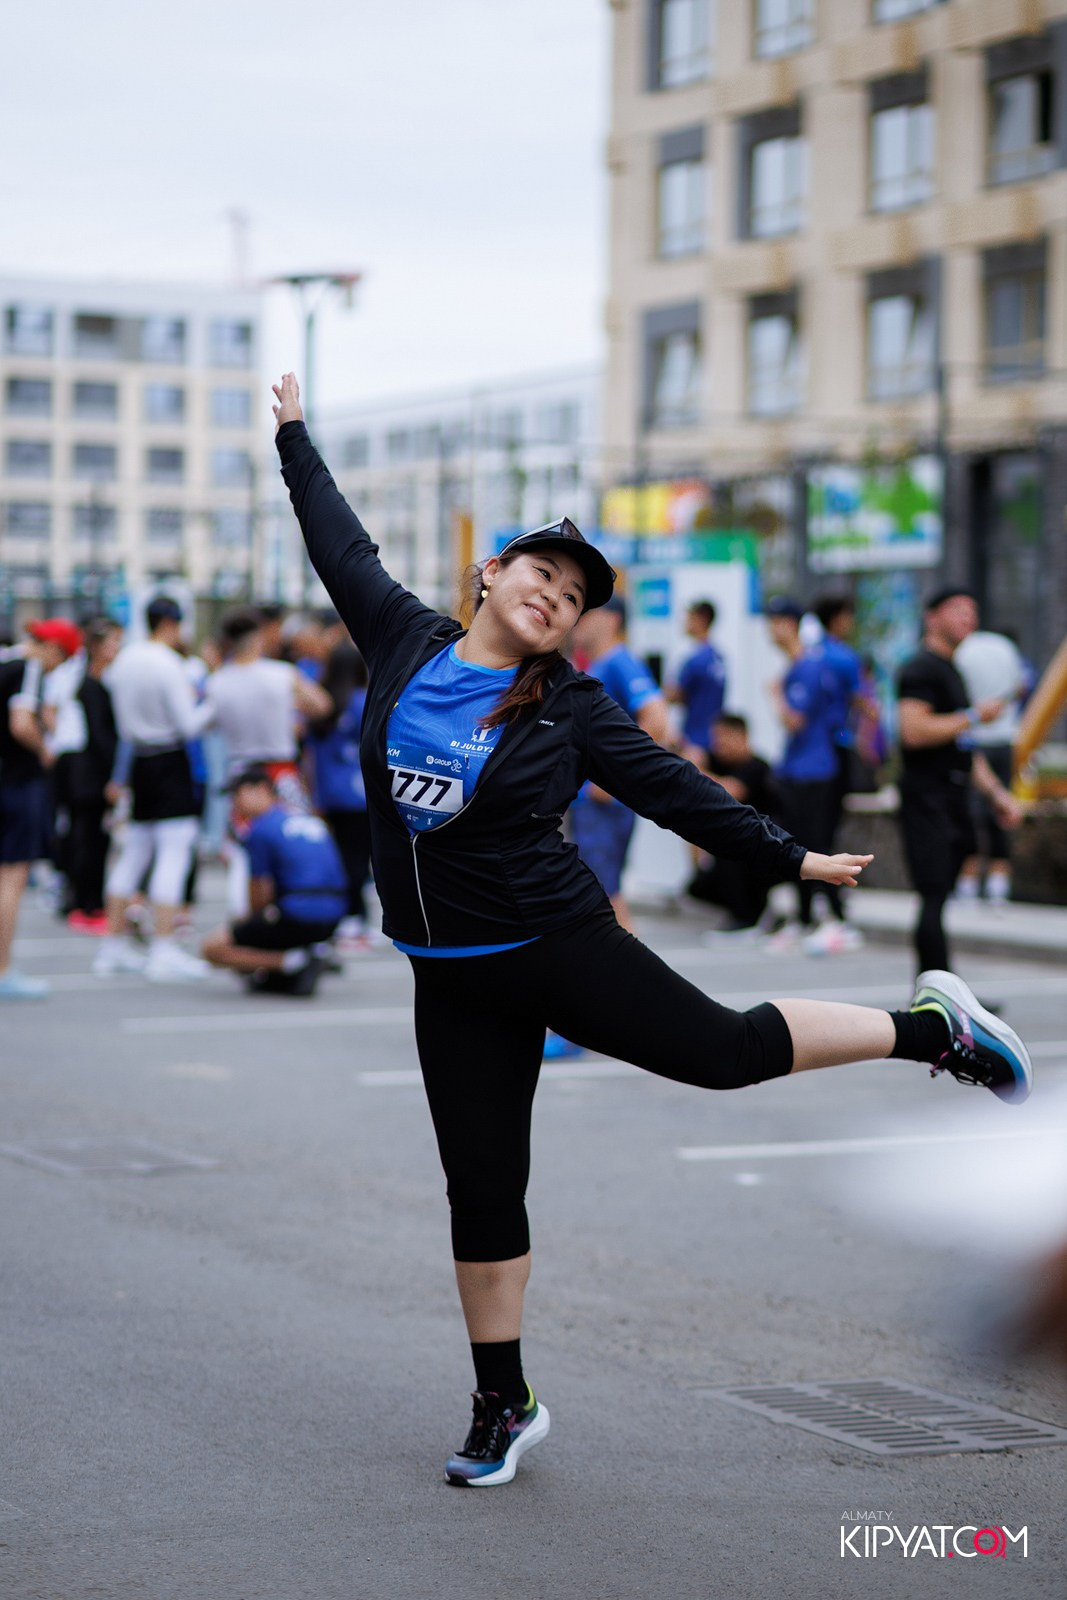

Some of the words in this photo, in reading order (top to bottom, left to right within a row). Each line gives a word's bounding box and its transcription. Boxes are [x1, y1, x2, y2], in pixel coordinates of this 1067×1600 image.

[450, 740, 460, 748] BI
[387, 748, 401, 758] KM
[434, 758, 452, 767] GROUP
